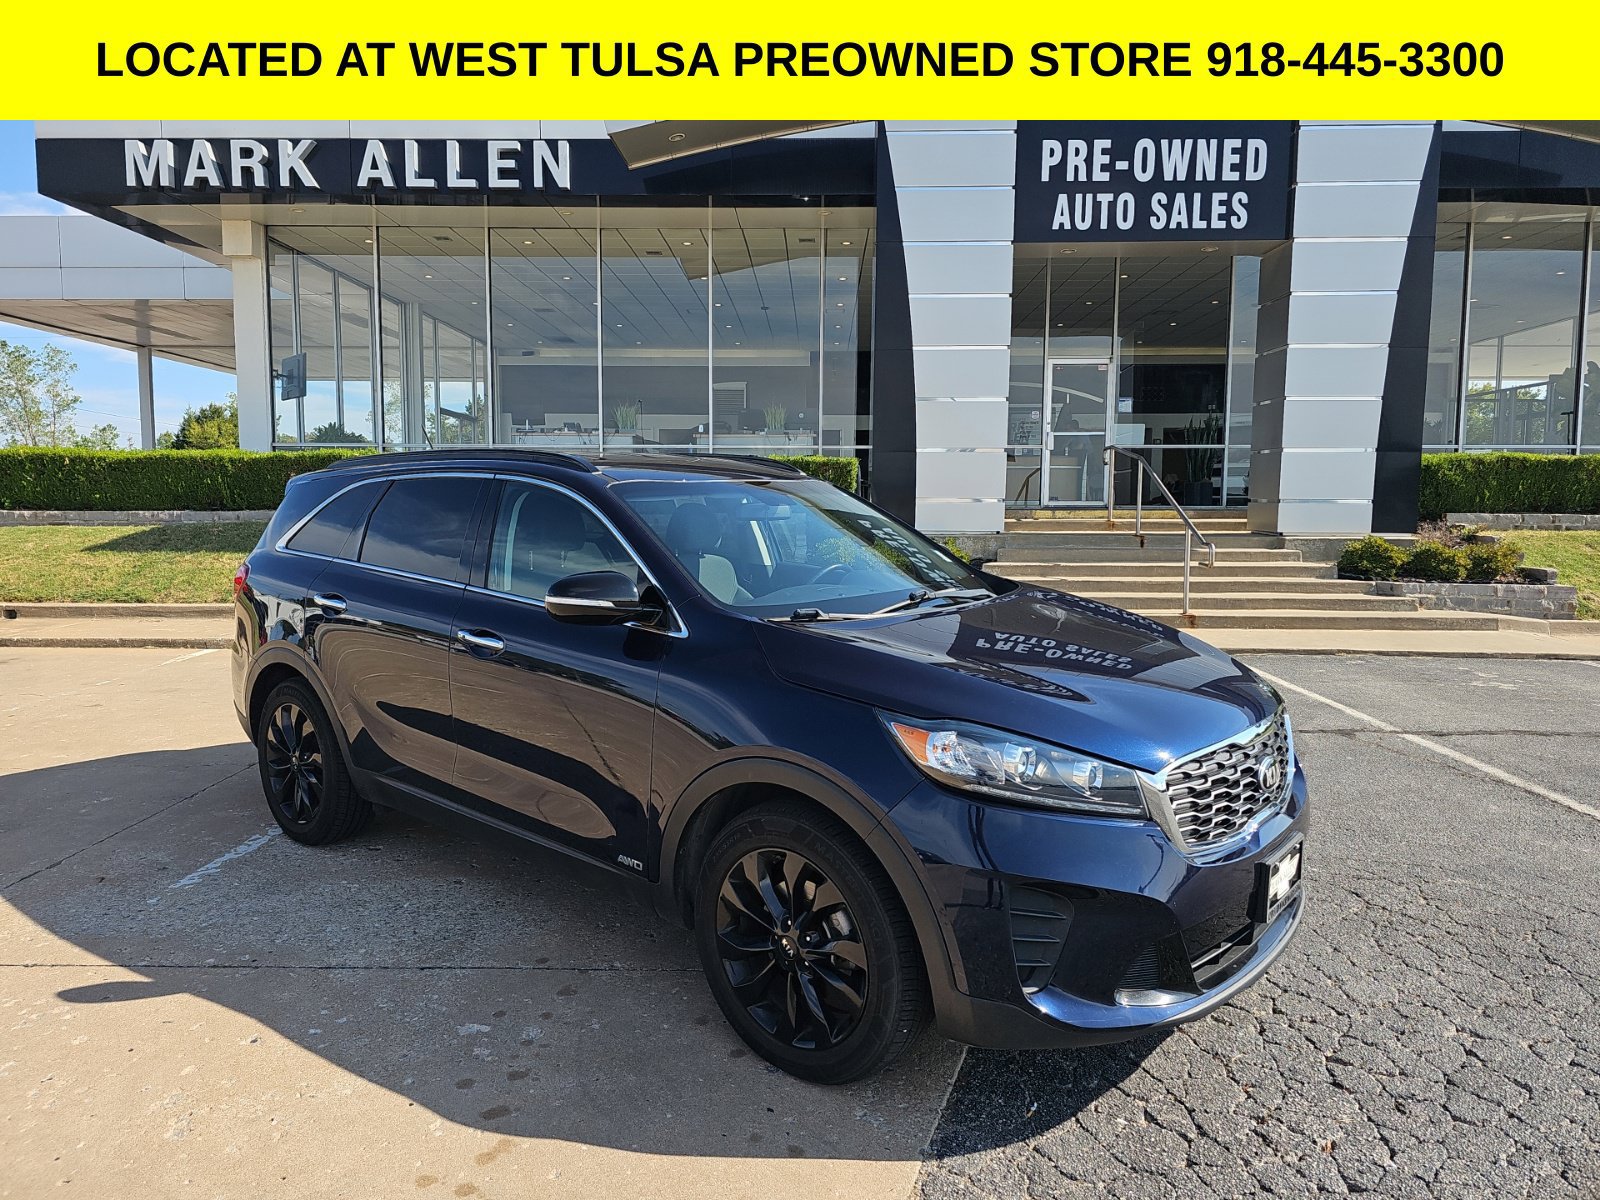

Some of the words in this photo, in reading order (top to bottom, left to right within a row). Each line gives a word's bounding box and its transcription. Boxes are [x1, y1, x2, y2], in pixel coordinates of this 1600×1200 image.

[124, 139, 321, 189] MARK
[357, 139, 571, 191] ALLEN
[1041, 138, 1268, 182] PRE-OWNED
[1051, 192, 1136, 231] AUTO
[1149, 191, 1249, 230] SALES
[617, 854, 643, 871] AWD
[781, 938, 794, 957] KIA
